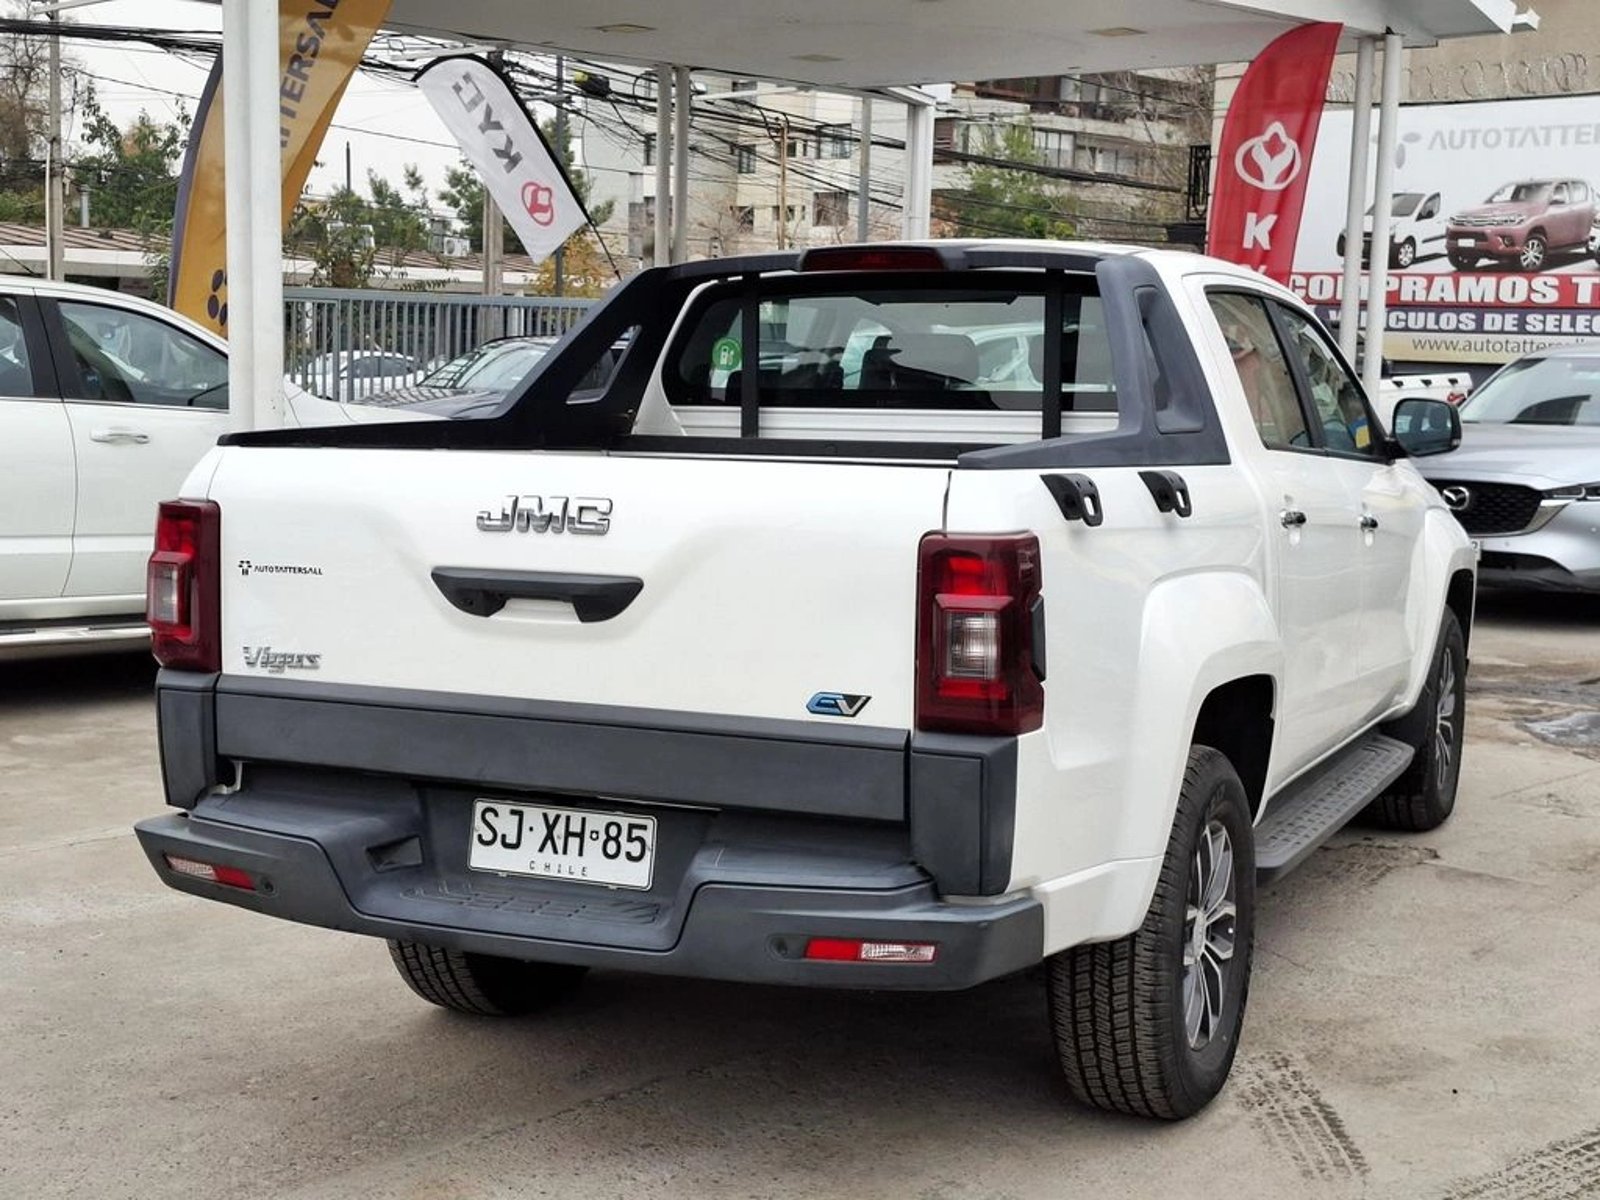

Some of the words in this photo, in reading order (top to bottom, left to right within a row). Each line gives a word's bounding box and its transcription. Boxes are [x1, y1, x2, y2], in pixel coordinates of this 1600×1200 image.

[1483, 312, 1519, 332] DE
[476, 494, 614, 537] JMC
[253, 564, 323, 576] AUTOTATTERSALL
[242, 646, 322, 673] Vigus
[528, 859, 589, 877] CHILE
